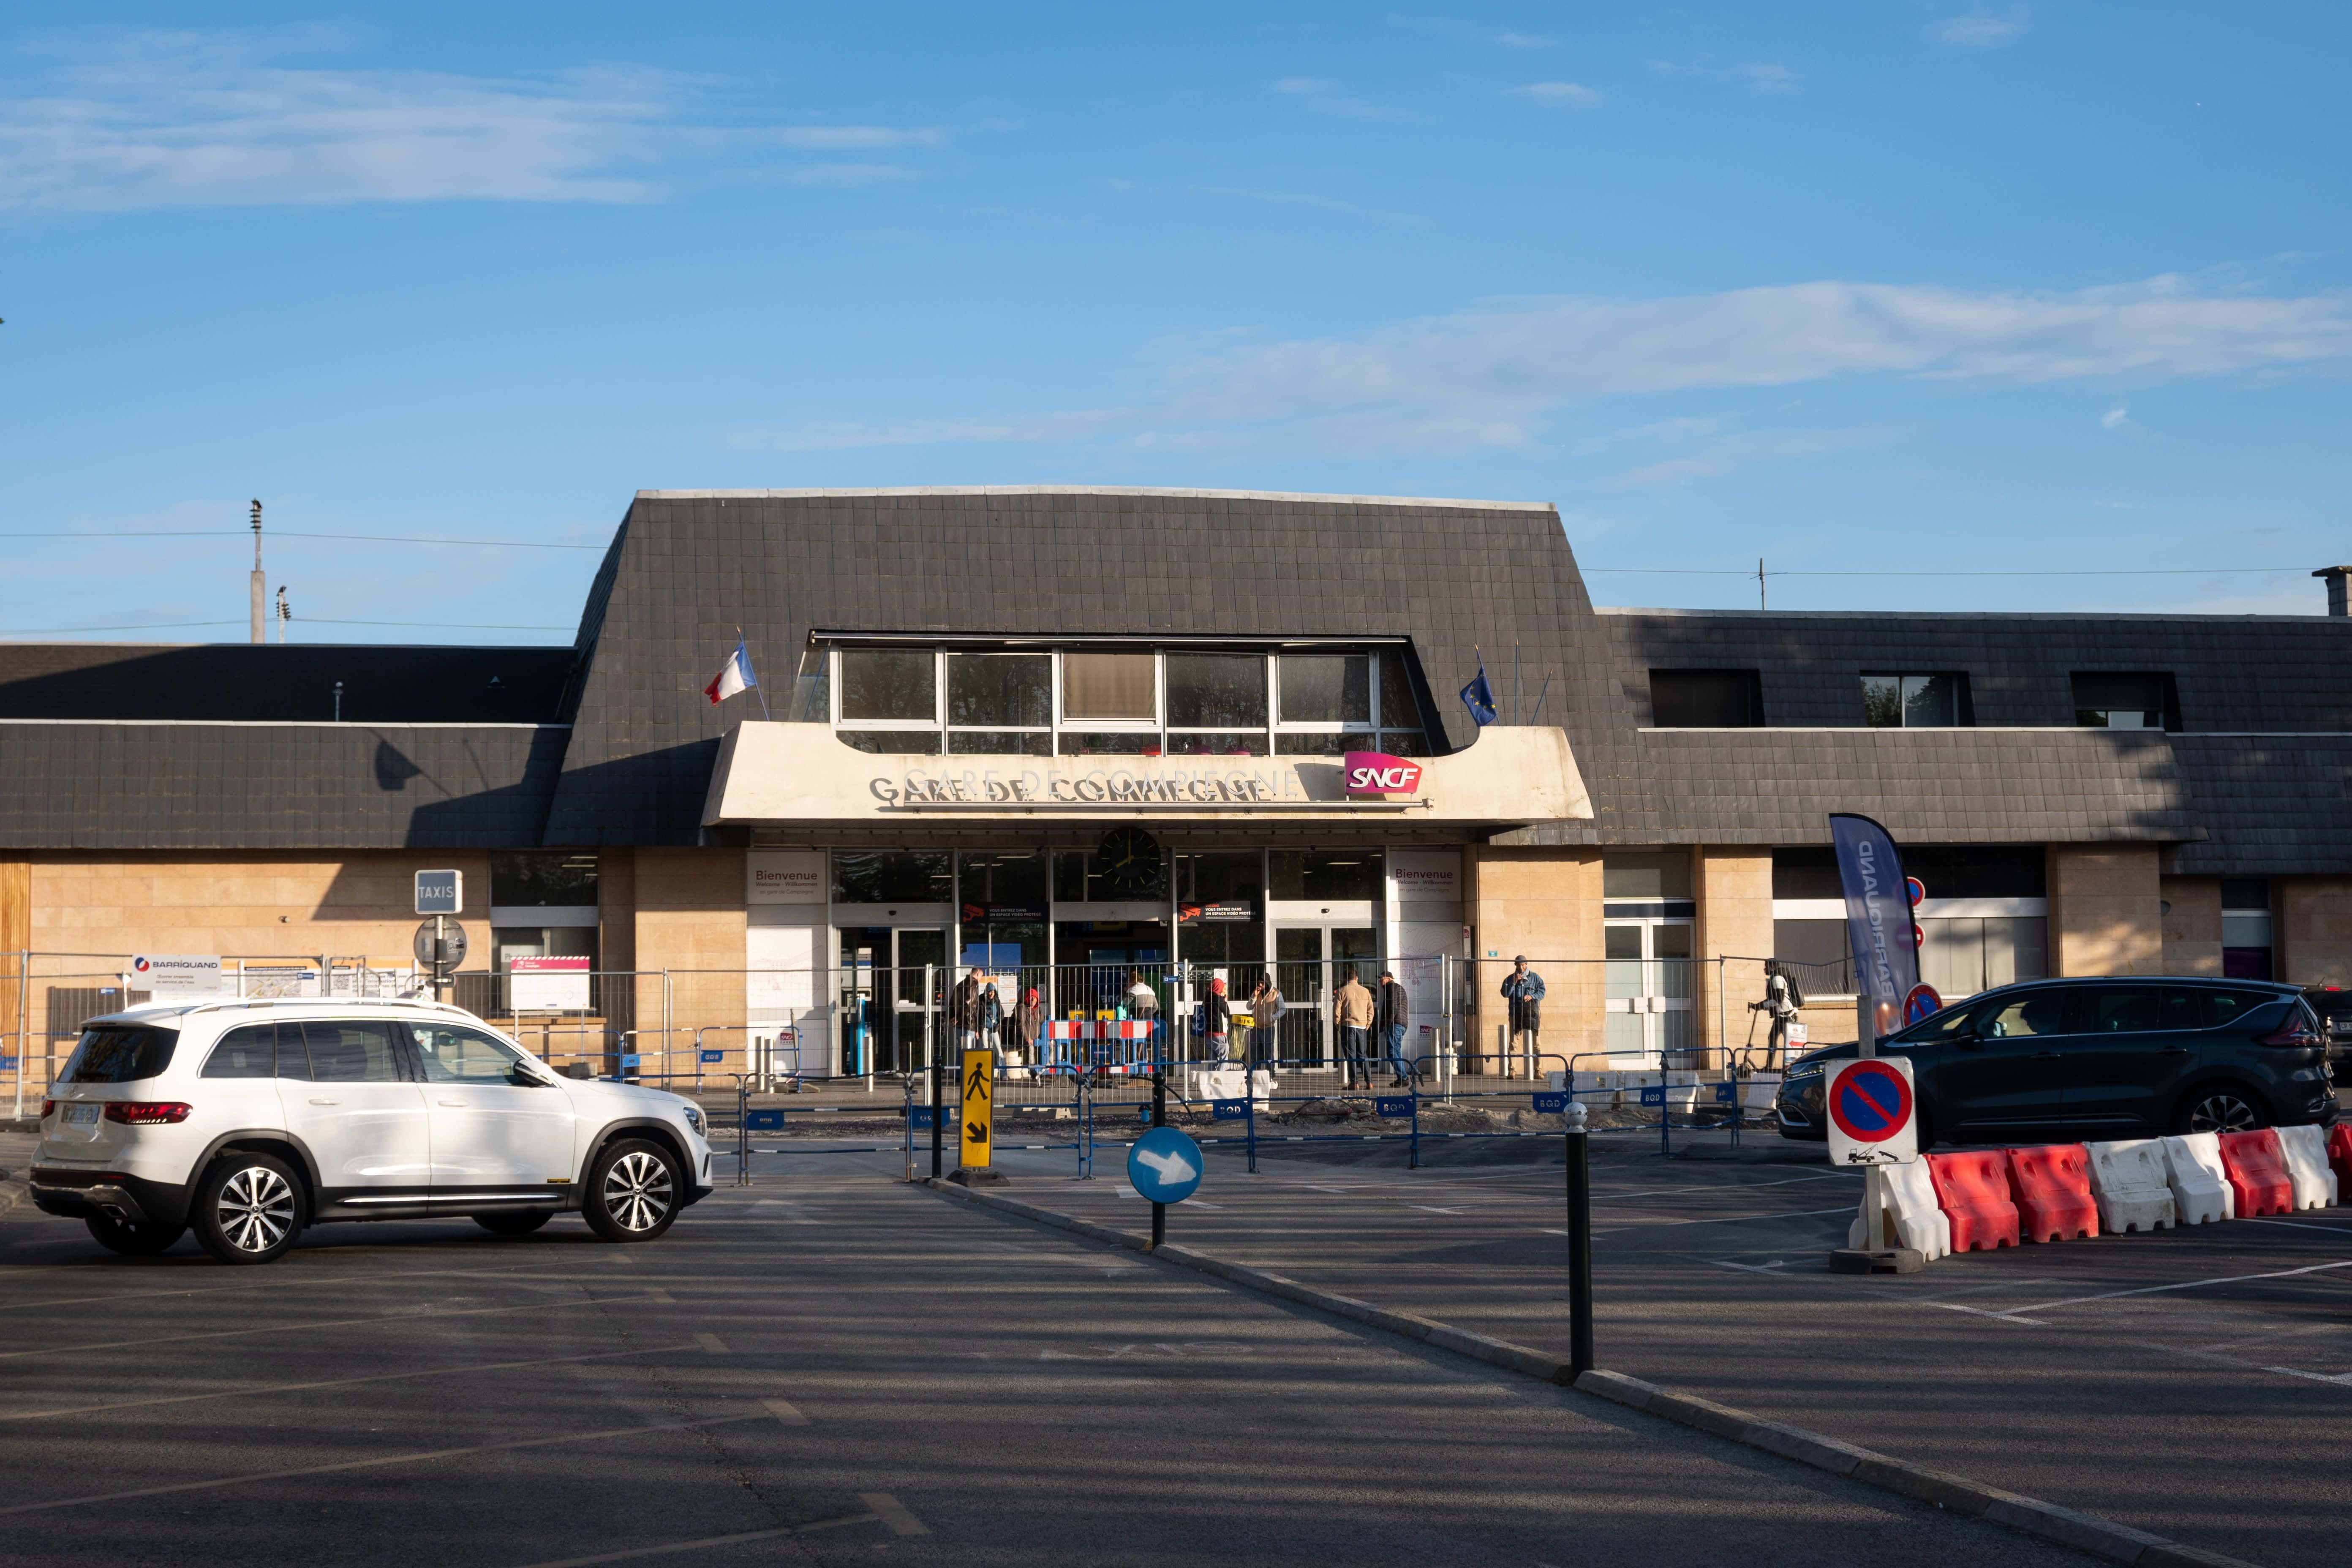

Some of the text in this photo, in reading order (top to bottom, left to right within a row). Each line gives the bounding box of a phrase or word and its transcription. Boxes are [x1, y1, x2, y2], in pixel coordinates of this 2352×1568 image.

[904, 769, 1298, 795] GARE DE COMPIEGNE
[1350, 768, 1418, 788] SNCF
[756, 870, 818, 880] Bienvenue
[1396, 869, 1453, 879] Bienvenue
[418, 886, 453, 898] TAXIS
[152, 960, 218, 969] BARRIQUAND
[1645, 1094, 1660, 1102] BQD
